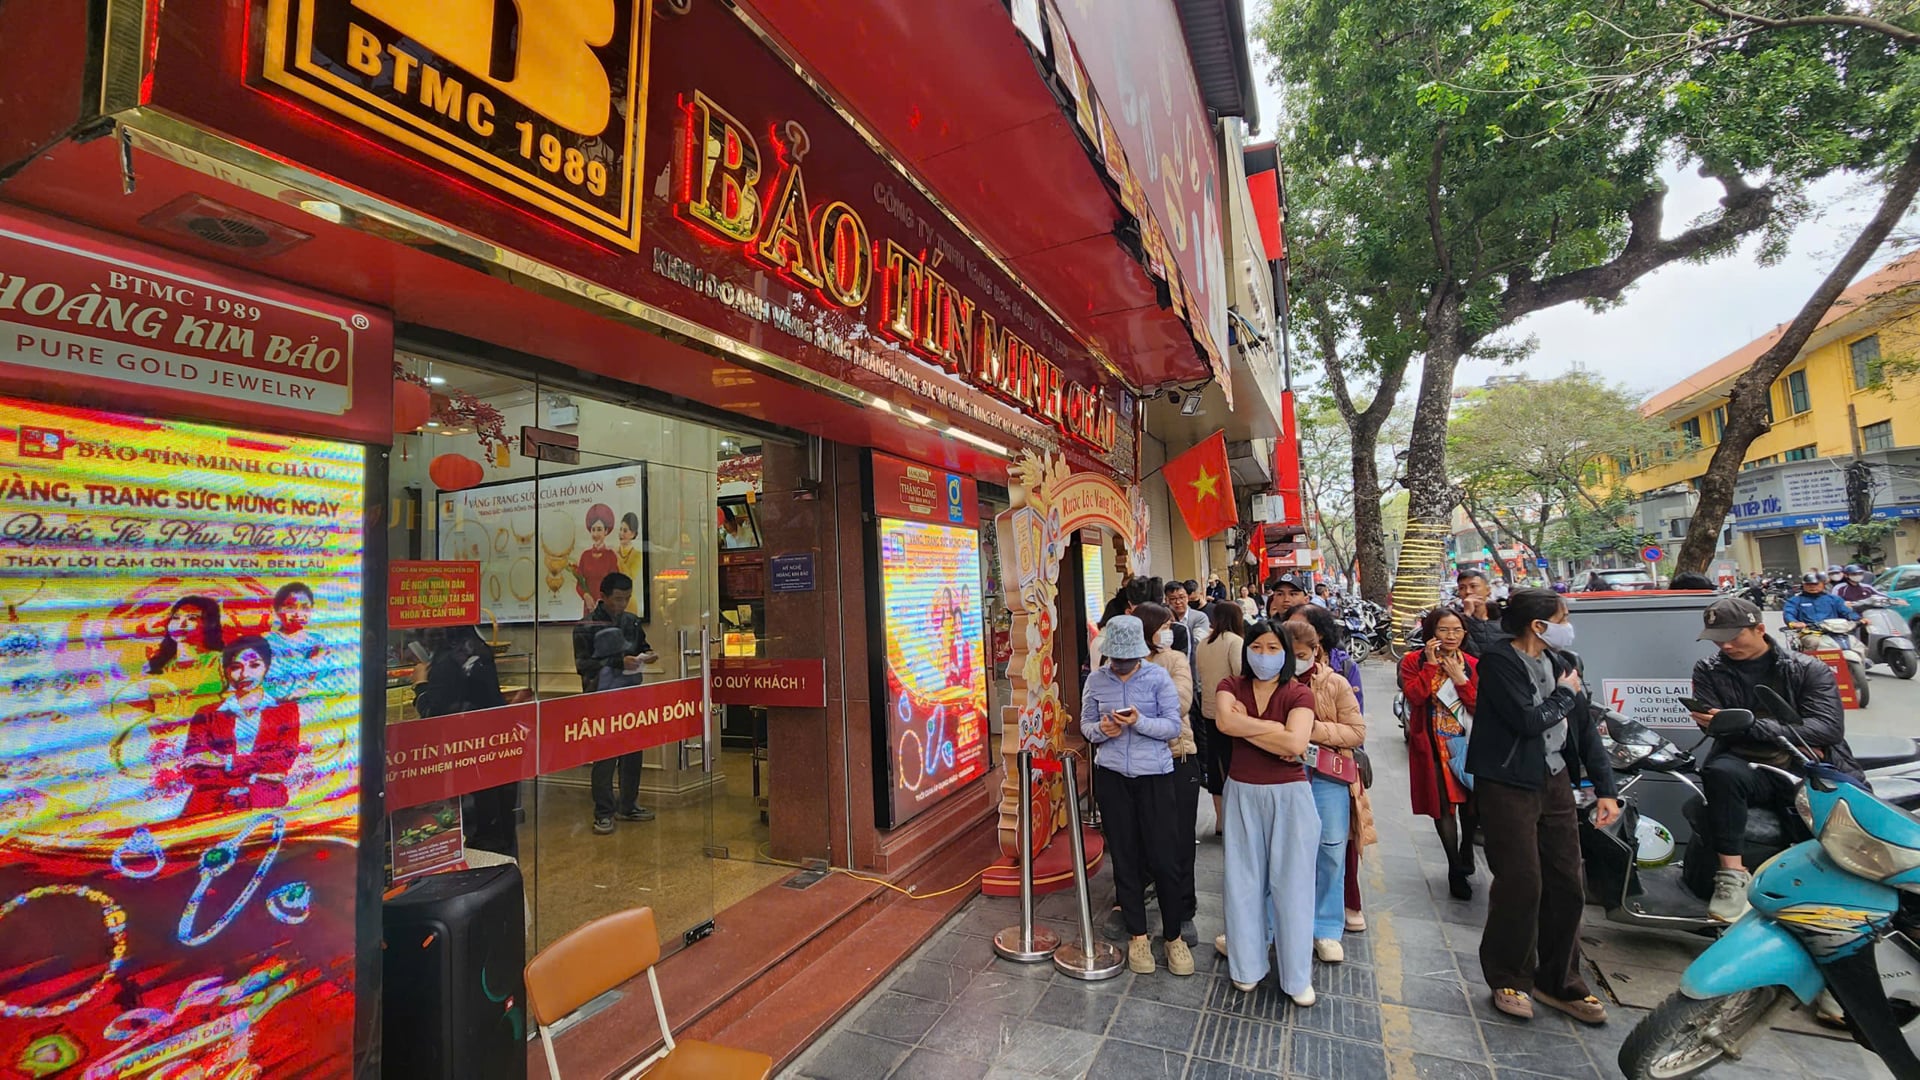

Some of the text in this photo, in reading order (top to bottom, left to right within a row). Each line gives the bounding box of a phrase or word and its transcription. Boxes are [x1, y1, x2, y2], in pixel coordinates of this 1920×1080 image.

[347, 22, 608, 196] BTMC 1989
[689, 88, 1117, 453] BẢO TÍN MINH CHÂU
[109, 271, 261, 322] BTMC 1989
[174, 315, 256, 358] KIM
[264, 334, 341, 373] BẢO
[705, 273, 770, 324] DOANH
[772, 305, 814, 344] VÀNG
[920, 379, 937, 401] SJC
[16, 334, 317, 401] PURE GOLD JEWELRY
[76, 439, 327, 479] BẢO TÍN MINH CHÂU
[84, 483, 170, 509] TRANG
[175, 488, 221, 511] SỨC
[226, 491, 287, 515] MỪNG
[291, 497, 341, 518] NGÀY
[492, 492, 518, 506] TRANG
[1082, 489, 1093, 511] Lộc
[1741, 494, 1760, 517] TIẾP
[1761, 494, 1782, 514] XÚC
[3, 512, 95, 546] Quốc
[103, 516, 152, 547] Tế
[281, 525, 328, 548] 8/3
[6, 555, 62, 568] THAY
[68, 554, 98, 567] LỜI
[104, 554, 145, 568] CẢM
[725, 674, 751, 688] QUÝ
[754, 674, 798, 689] KHÁCH
[1627, 684, 1662, 695] DỪNG
[564, 717, 605, 743] HÂN
[610, 707, 659, 733] HOAN
[662, 700, 695, 722] ĐÓN
[410, 743, 439, 762] TÍN
[443, 737, 486, 756] MINH
[489, 727, 529, 747] CHÂU
[400, 767, 417, 779] TÍN
[420, 761, 453, 776] NHIỆM
[455, 755, 476, 768] HƠN
[478, 751, 497, 763] GIỮ
[498, 746, 523, 759] VÀNG
